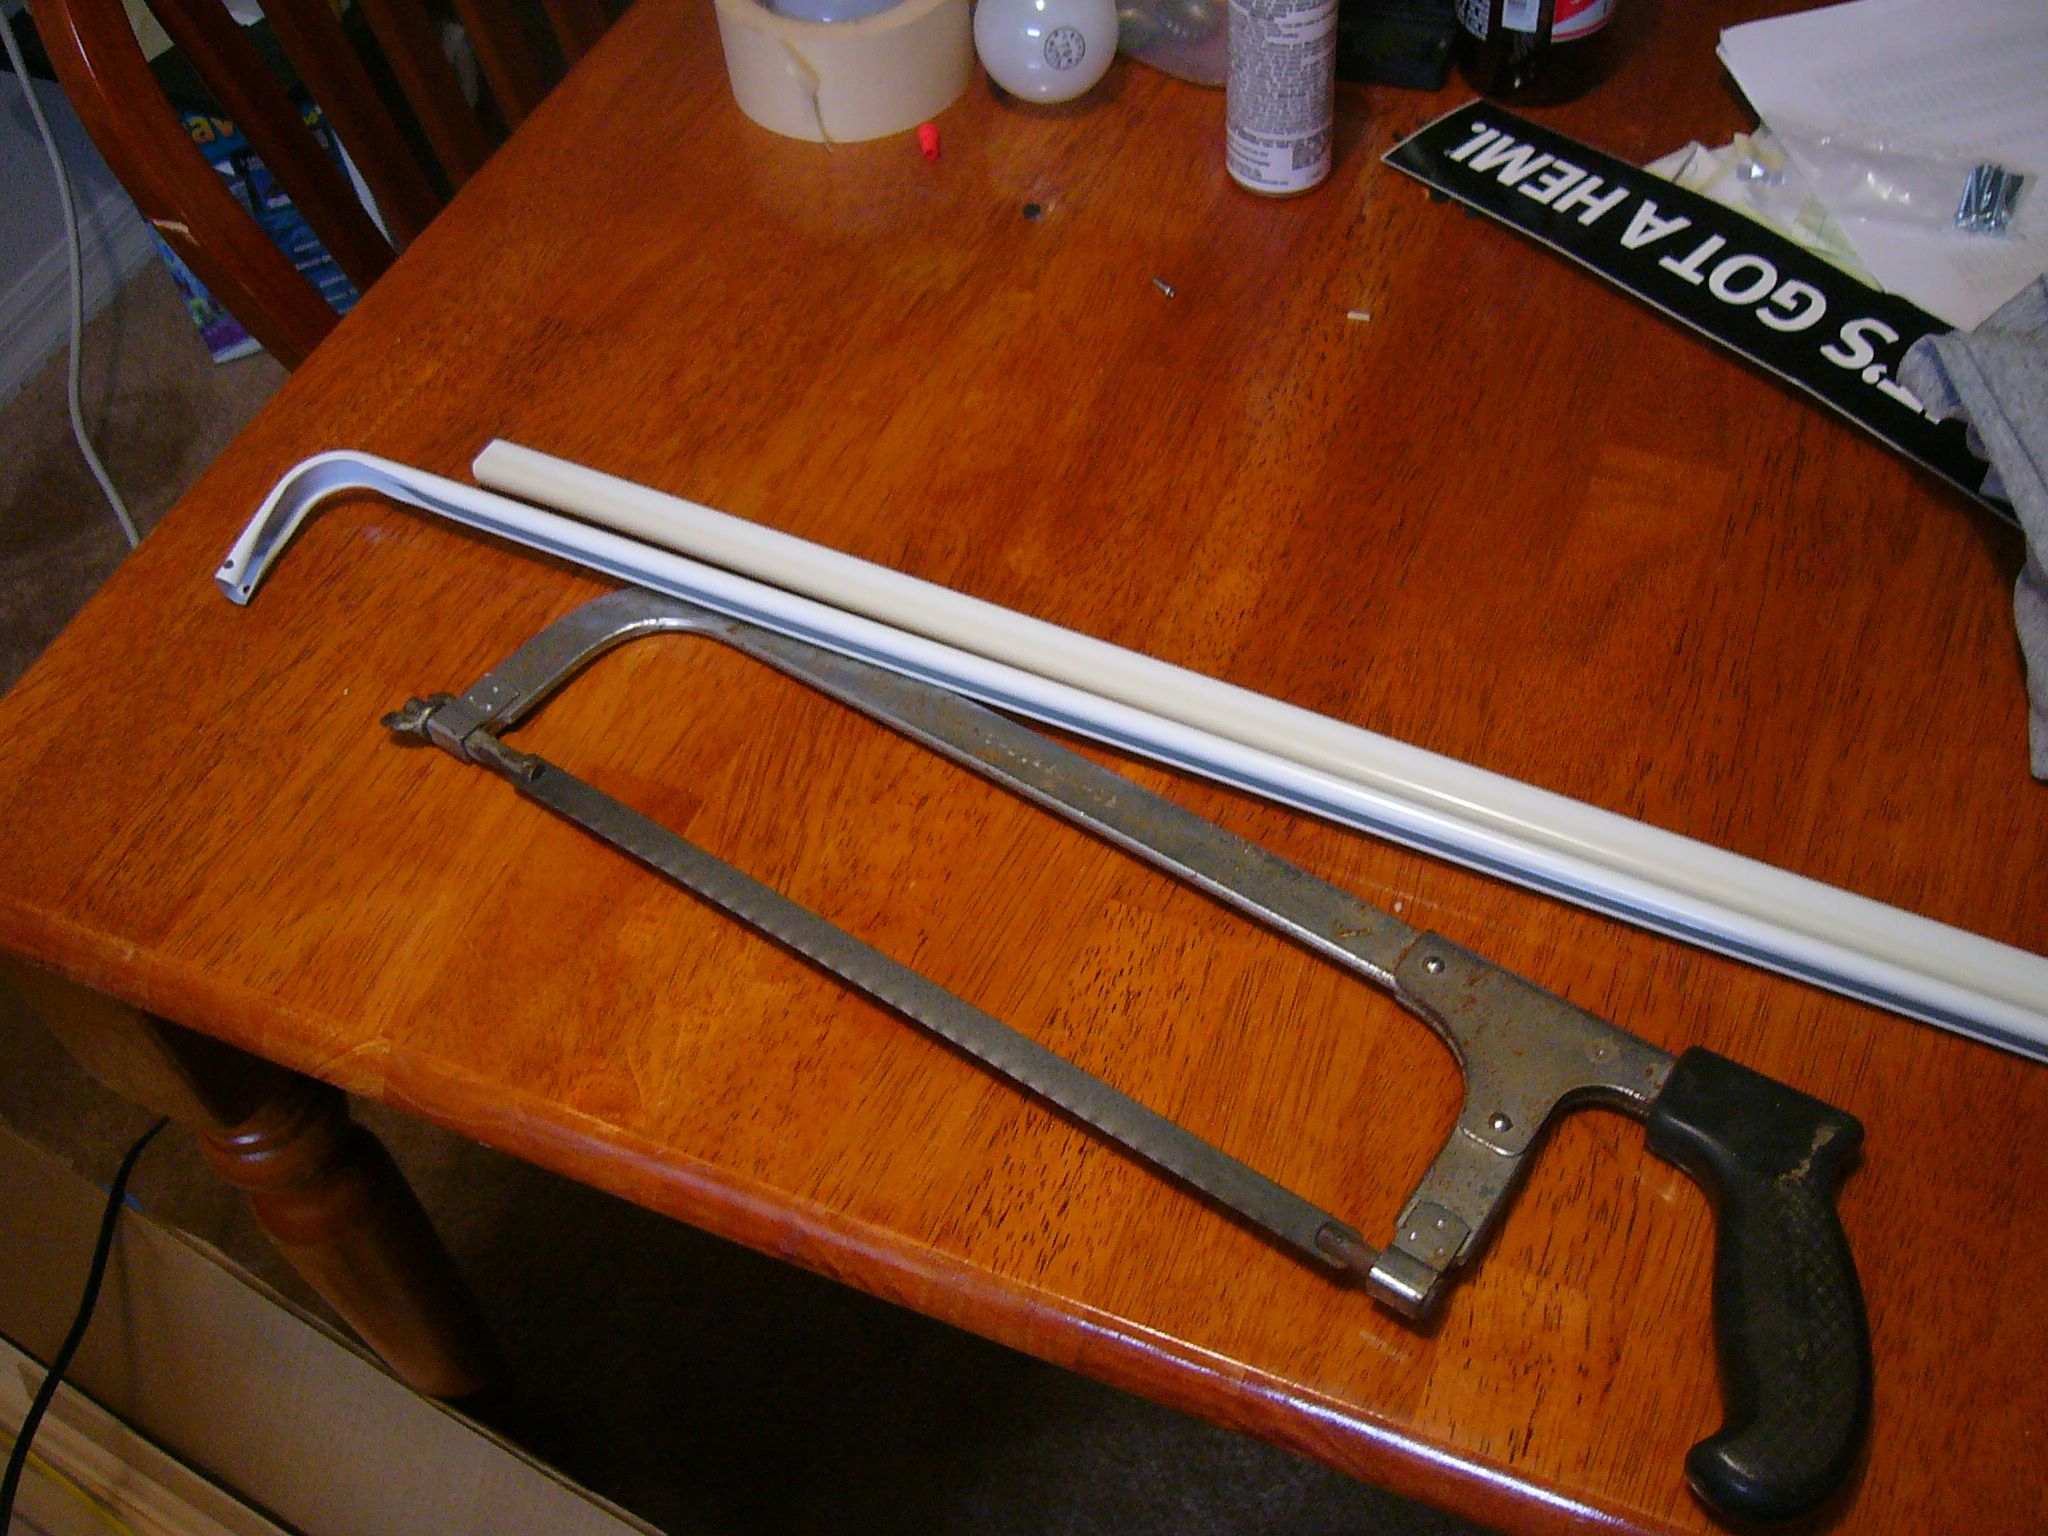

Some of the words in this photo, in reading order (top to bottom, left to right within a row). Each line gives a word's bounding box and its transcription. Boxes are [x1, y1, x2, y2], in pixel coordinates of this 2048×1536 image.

[1448, 121, 1631, 226] HEMI.
[1619, 199, 1692, 250] A
[1658, 234, 1827, 332] GOT
[1820, 318, 1939, 425] T'S
